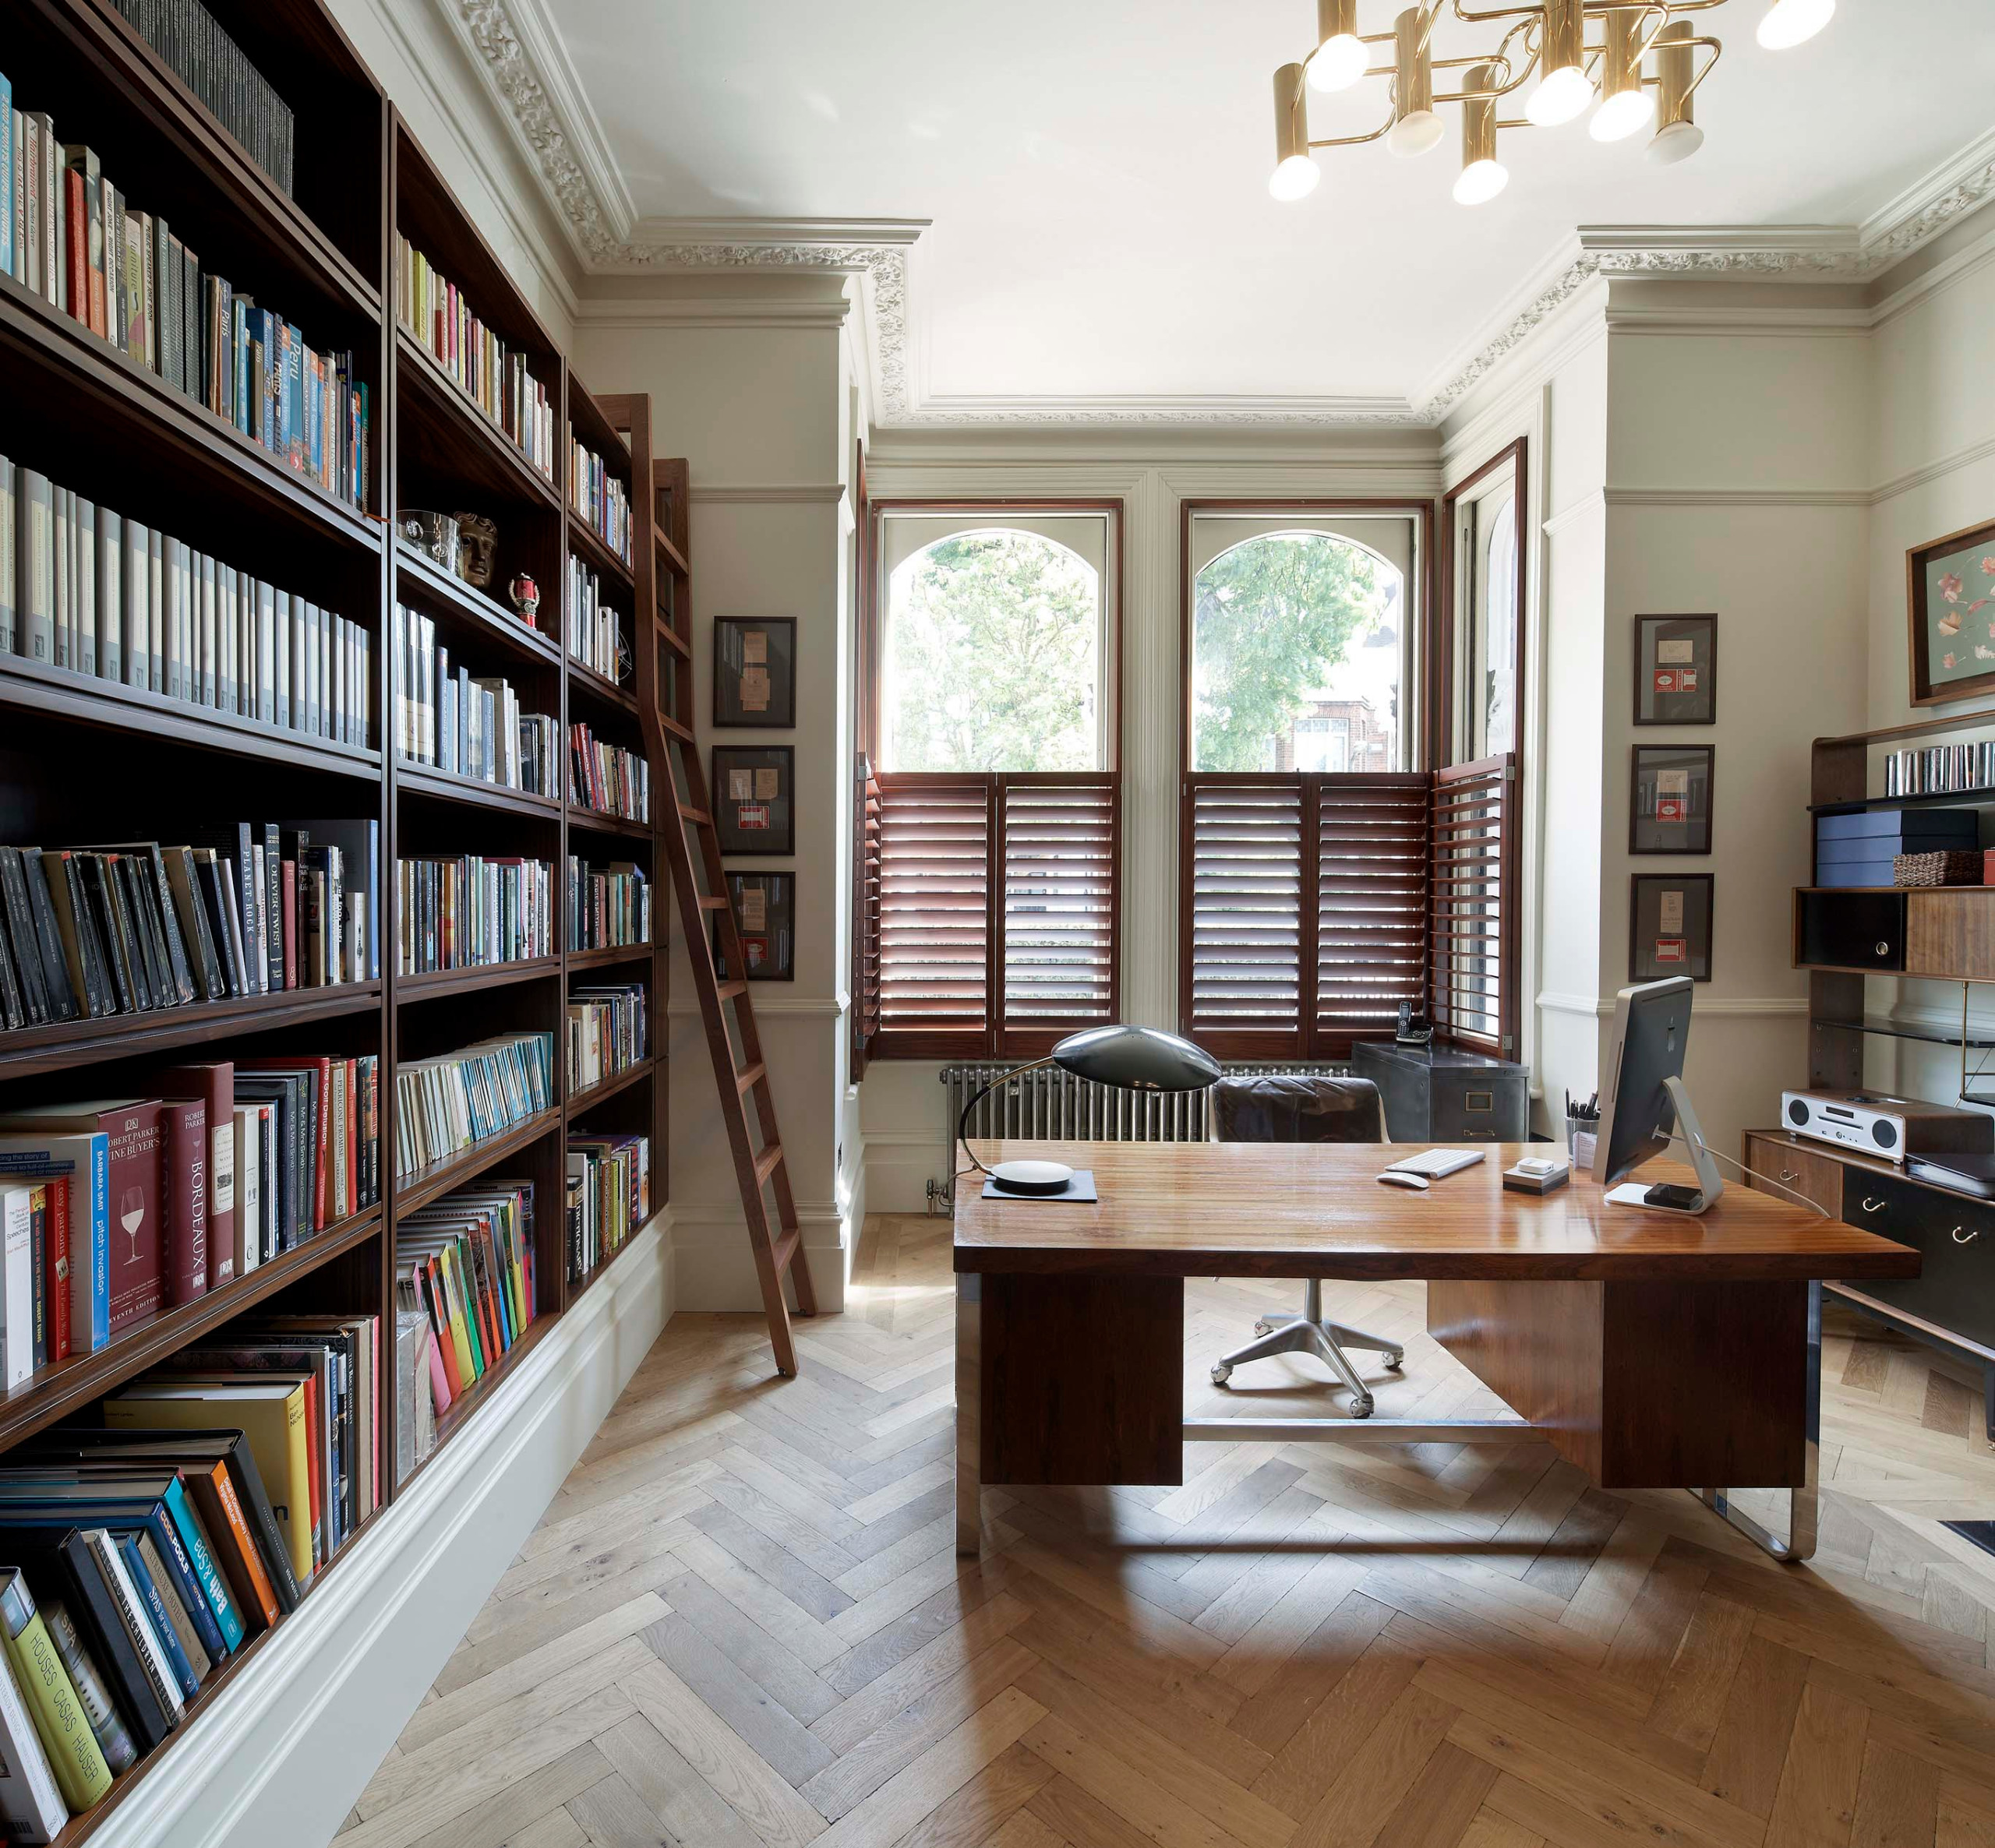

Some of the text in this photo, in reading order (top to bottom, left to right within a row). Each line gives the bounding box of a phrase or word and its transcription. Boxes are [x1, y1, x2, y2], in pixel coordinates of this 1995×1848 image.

[129, 240, 139, 290] furniture
[290, 341, 301, 380] Peru
[274, 361, 282, 396] PARIS
[242, 851, 252, 897] PLANET
[245, 904, 254, 933] ROCK
[270, 864, 281, 948] OLIVER TWIST
[185, 1109, 205, 1122] ROBERT
[290, 1111, 295, 1123] Mr
[300, 1106, 306, 1119] Mr
[312, 1101, 316, 1113] Mr
[108, 1126, 160, 1148] OBERT PARKER
[125, 1118, 139, 1131] DK
[185, 1118, 206, 1130] PARKER
[127, 1138, 161, 1156] BUYER'S
[96, 1150, 104, 1185] BARBARA
[192, 1161, 204, 1269] BORDEAUX
[6, 1227, 30, 1240] Speeches
[57, 1211, 65, 1255] parsons
[96, 1220, 105, 1248] pitch
[97, 1250, 105, 1296] invasion
[192, 1272, 205, 1289] DK
[219, 1258, 233, 1278] DK
[136, 1294, 160, 1310] EDITION
[289, 1409, 298, 1420] Ben
[231, 1497, 249, 1534] Contemporary
[194, 1537, 228, 1616] Bath & Spa
[96, 1541, 122, 1596] SALGADO
[121, 1597, 132, 1620] THE
[130, 1619, 156, 1673] CHILDREN
[148, 1585, 162, 1613] SPAS
[161, 1620, 169, 1636] your
[168, 1631, 176, 1649] home
[168, 1594, 183, 1624] HOTELS
[61, 1613, 76, 1649] SPA
[30, 1631, 99, 1784] HOUSES CASAS HÄUSER
